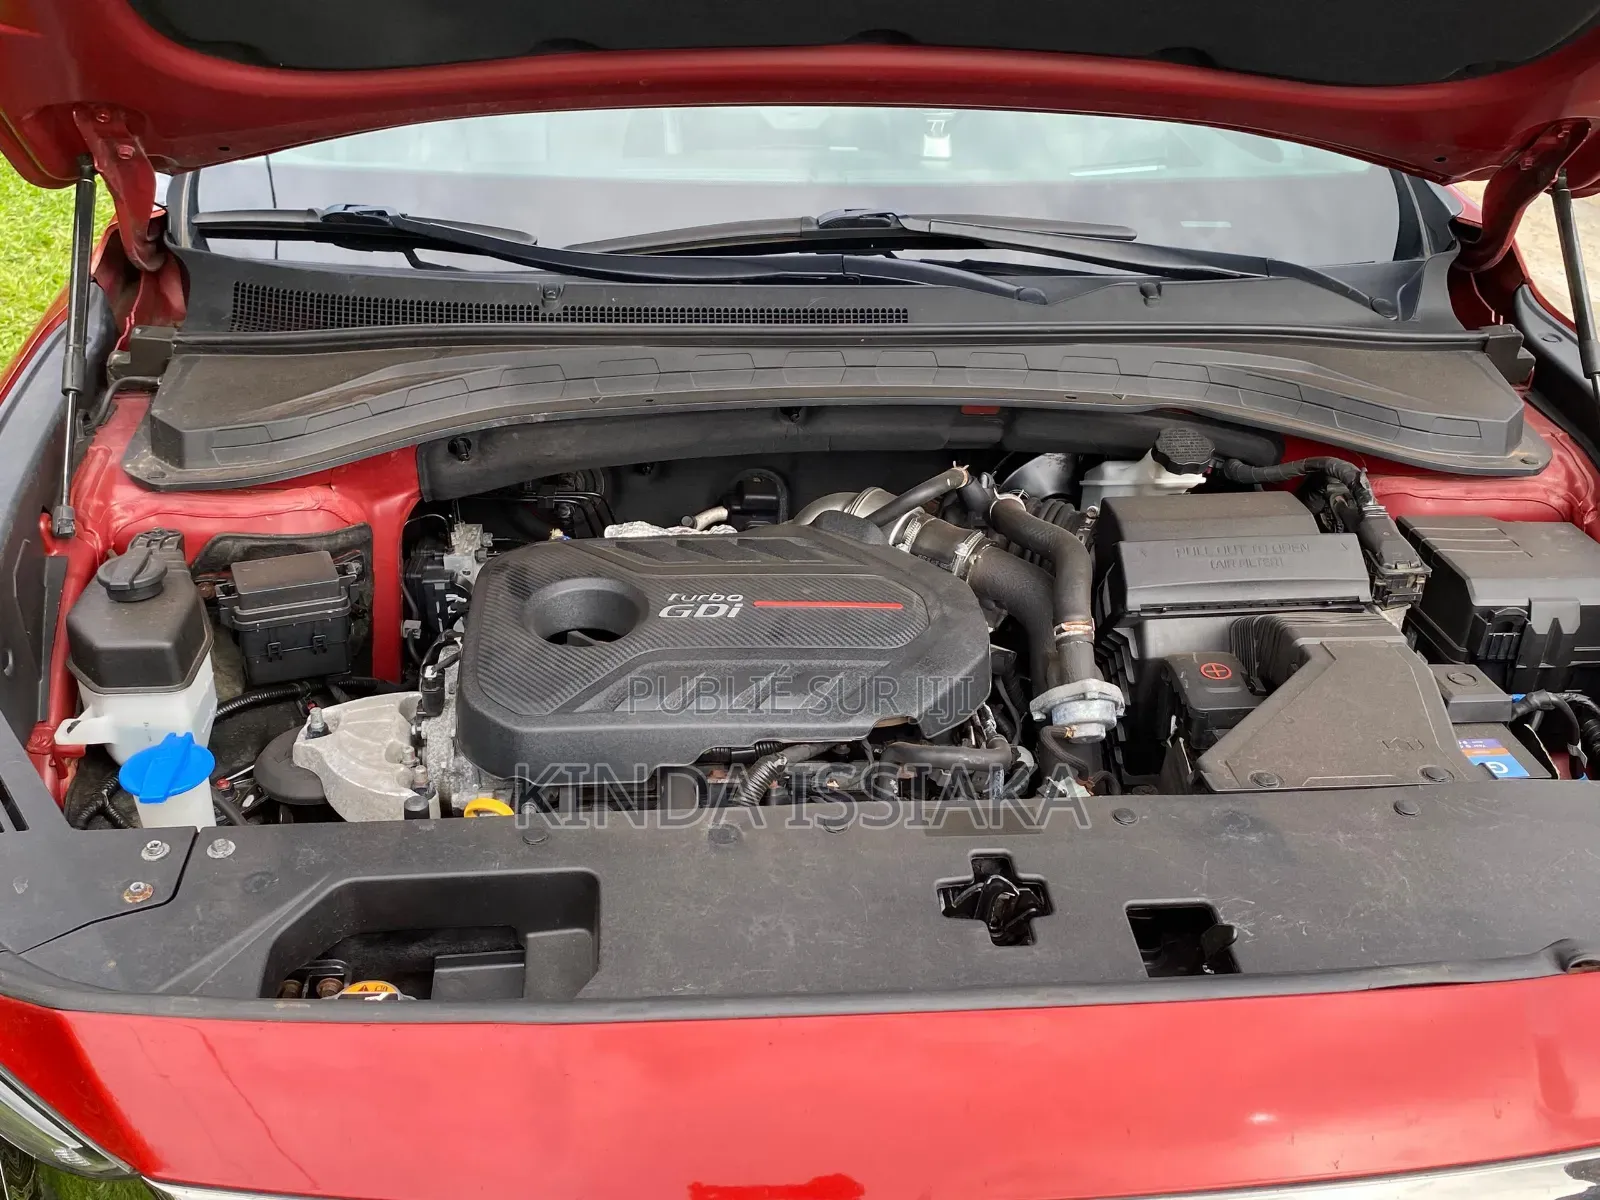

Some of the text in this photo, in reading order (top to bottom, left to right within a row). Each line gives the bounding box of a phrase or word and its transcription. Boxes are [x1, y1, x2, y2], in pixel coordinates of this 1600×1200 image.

[1175, 541, 1310, 558] PULL OUT TO OPEN
[658, 602, 744, 618] GDi
